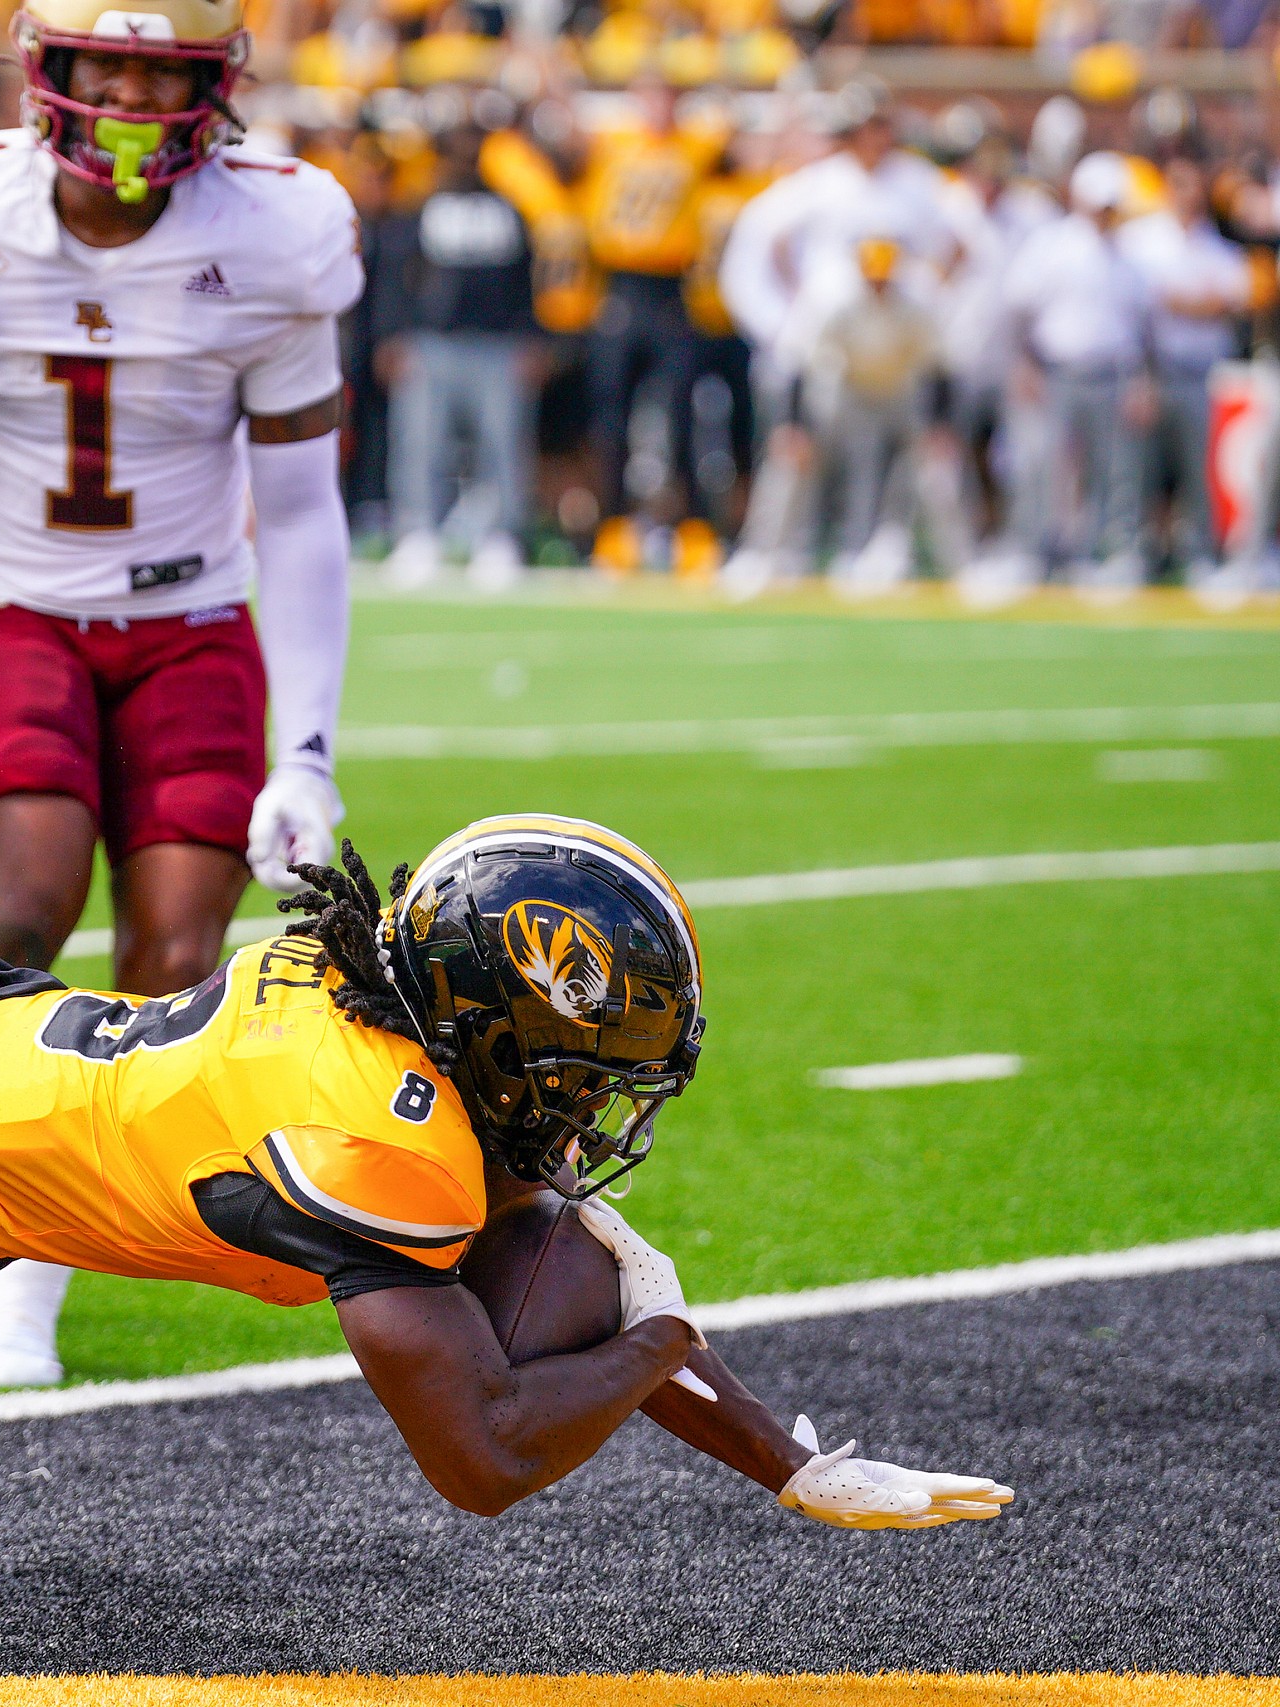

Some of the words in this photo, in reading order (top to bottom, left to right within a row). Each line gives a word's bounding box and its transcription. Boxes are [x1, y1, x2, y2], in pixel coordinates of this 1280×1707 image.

[43, 354, 134, 531] 1
[255, 933, 327, 1006] OEL
[389, 1069, 437, 1125] 8
